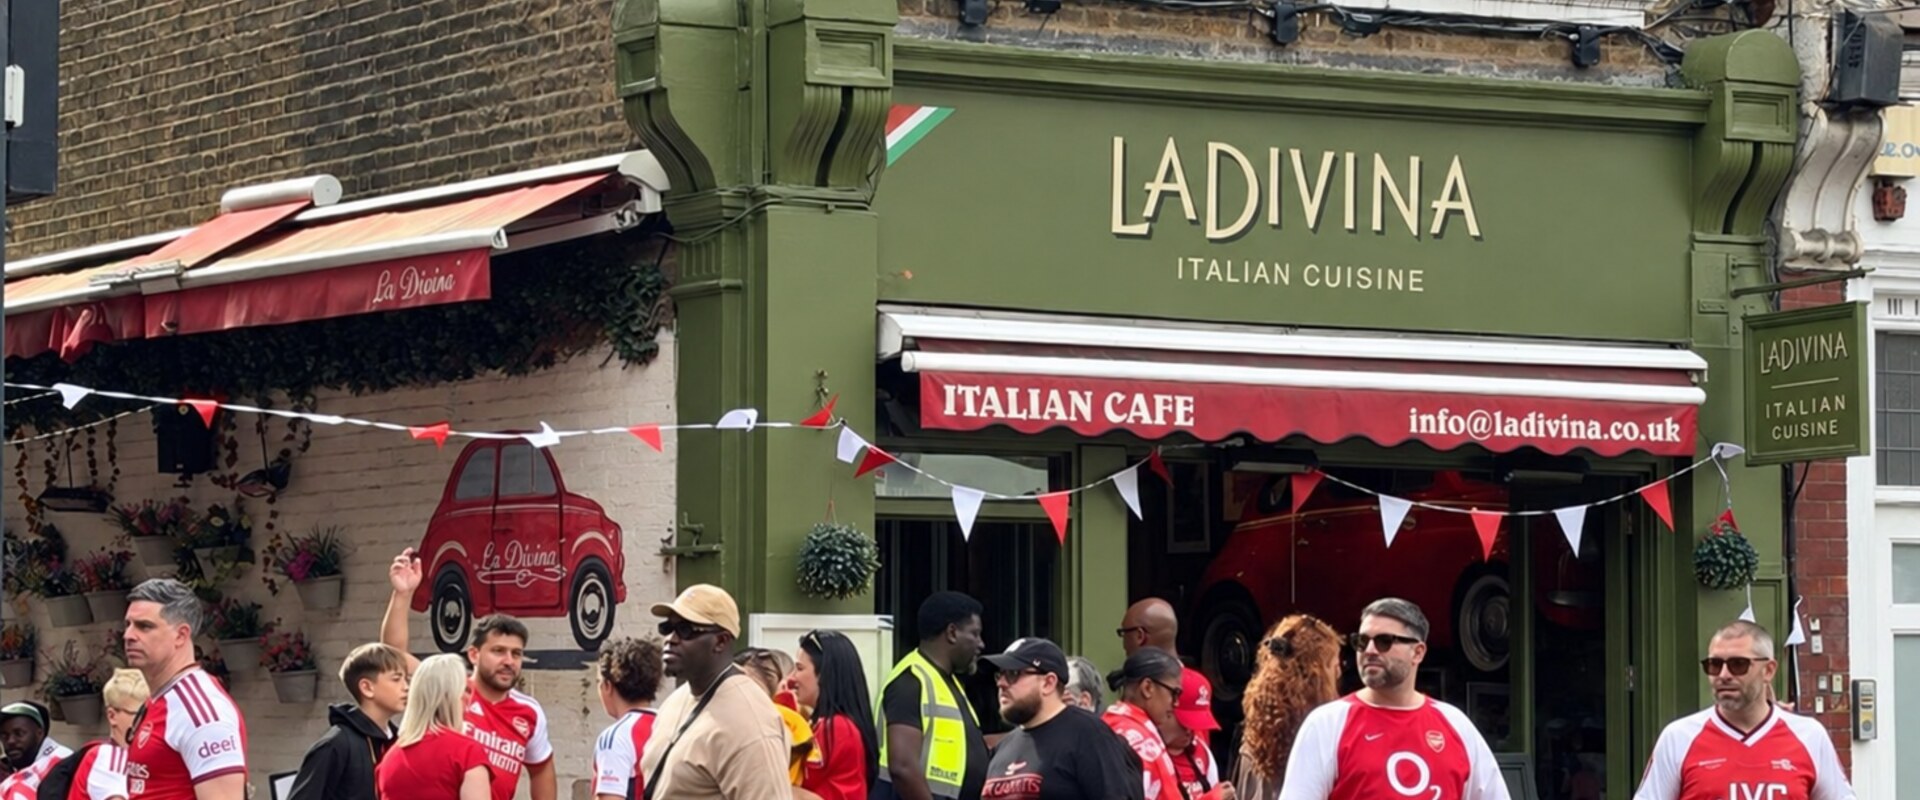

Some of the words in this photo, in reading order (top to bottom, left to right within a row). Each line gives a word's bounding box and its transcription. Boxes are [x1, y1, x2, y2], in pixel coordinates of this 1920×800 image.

[1111, 136, 1482, 240] LADIVINA
[372, 269, 396, 304] La
[1177, 256, 1291, 286] ITALIAN
[1302, 263, 1425, 293] CUISINE
[1760, 331, 1849, 374] LADIVINA
[942, 383, 1094, 423] ITALIAN
[1103, 391, 1196, 427] CAFE
[1765, 394, 1847, 419] ITALIAN
[1408, 407, 1682, 443] info@ladivina.co.uk
[1771, 418, 1839, 441] CUISINE
[481, 541, 501, 571] La
[504, 539, 557, 570] Divina
